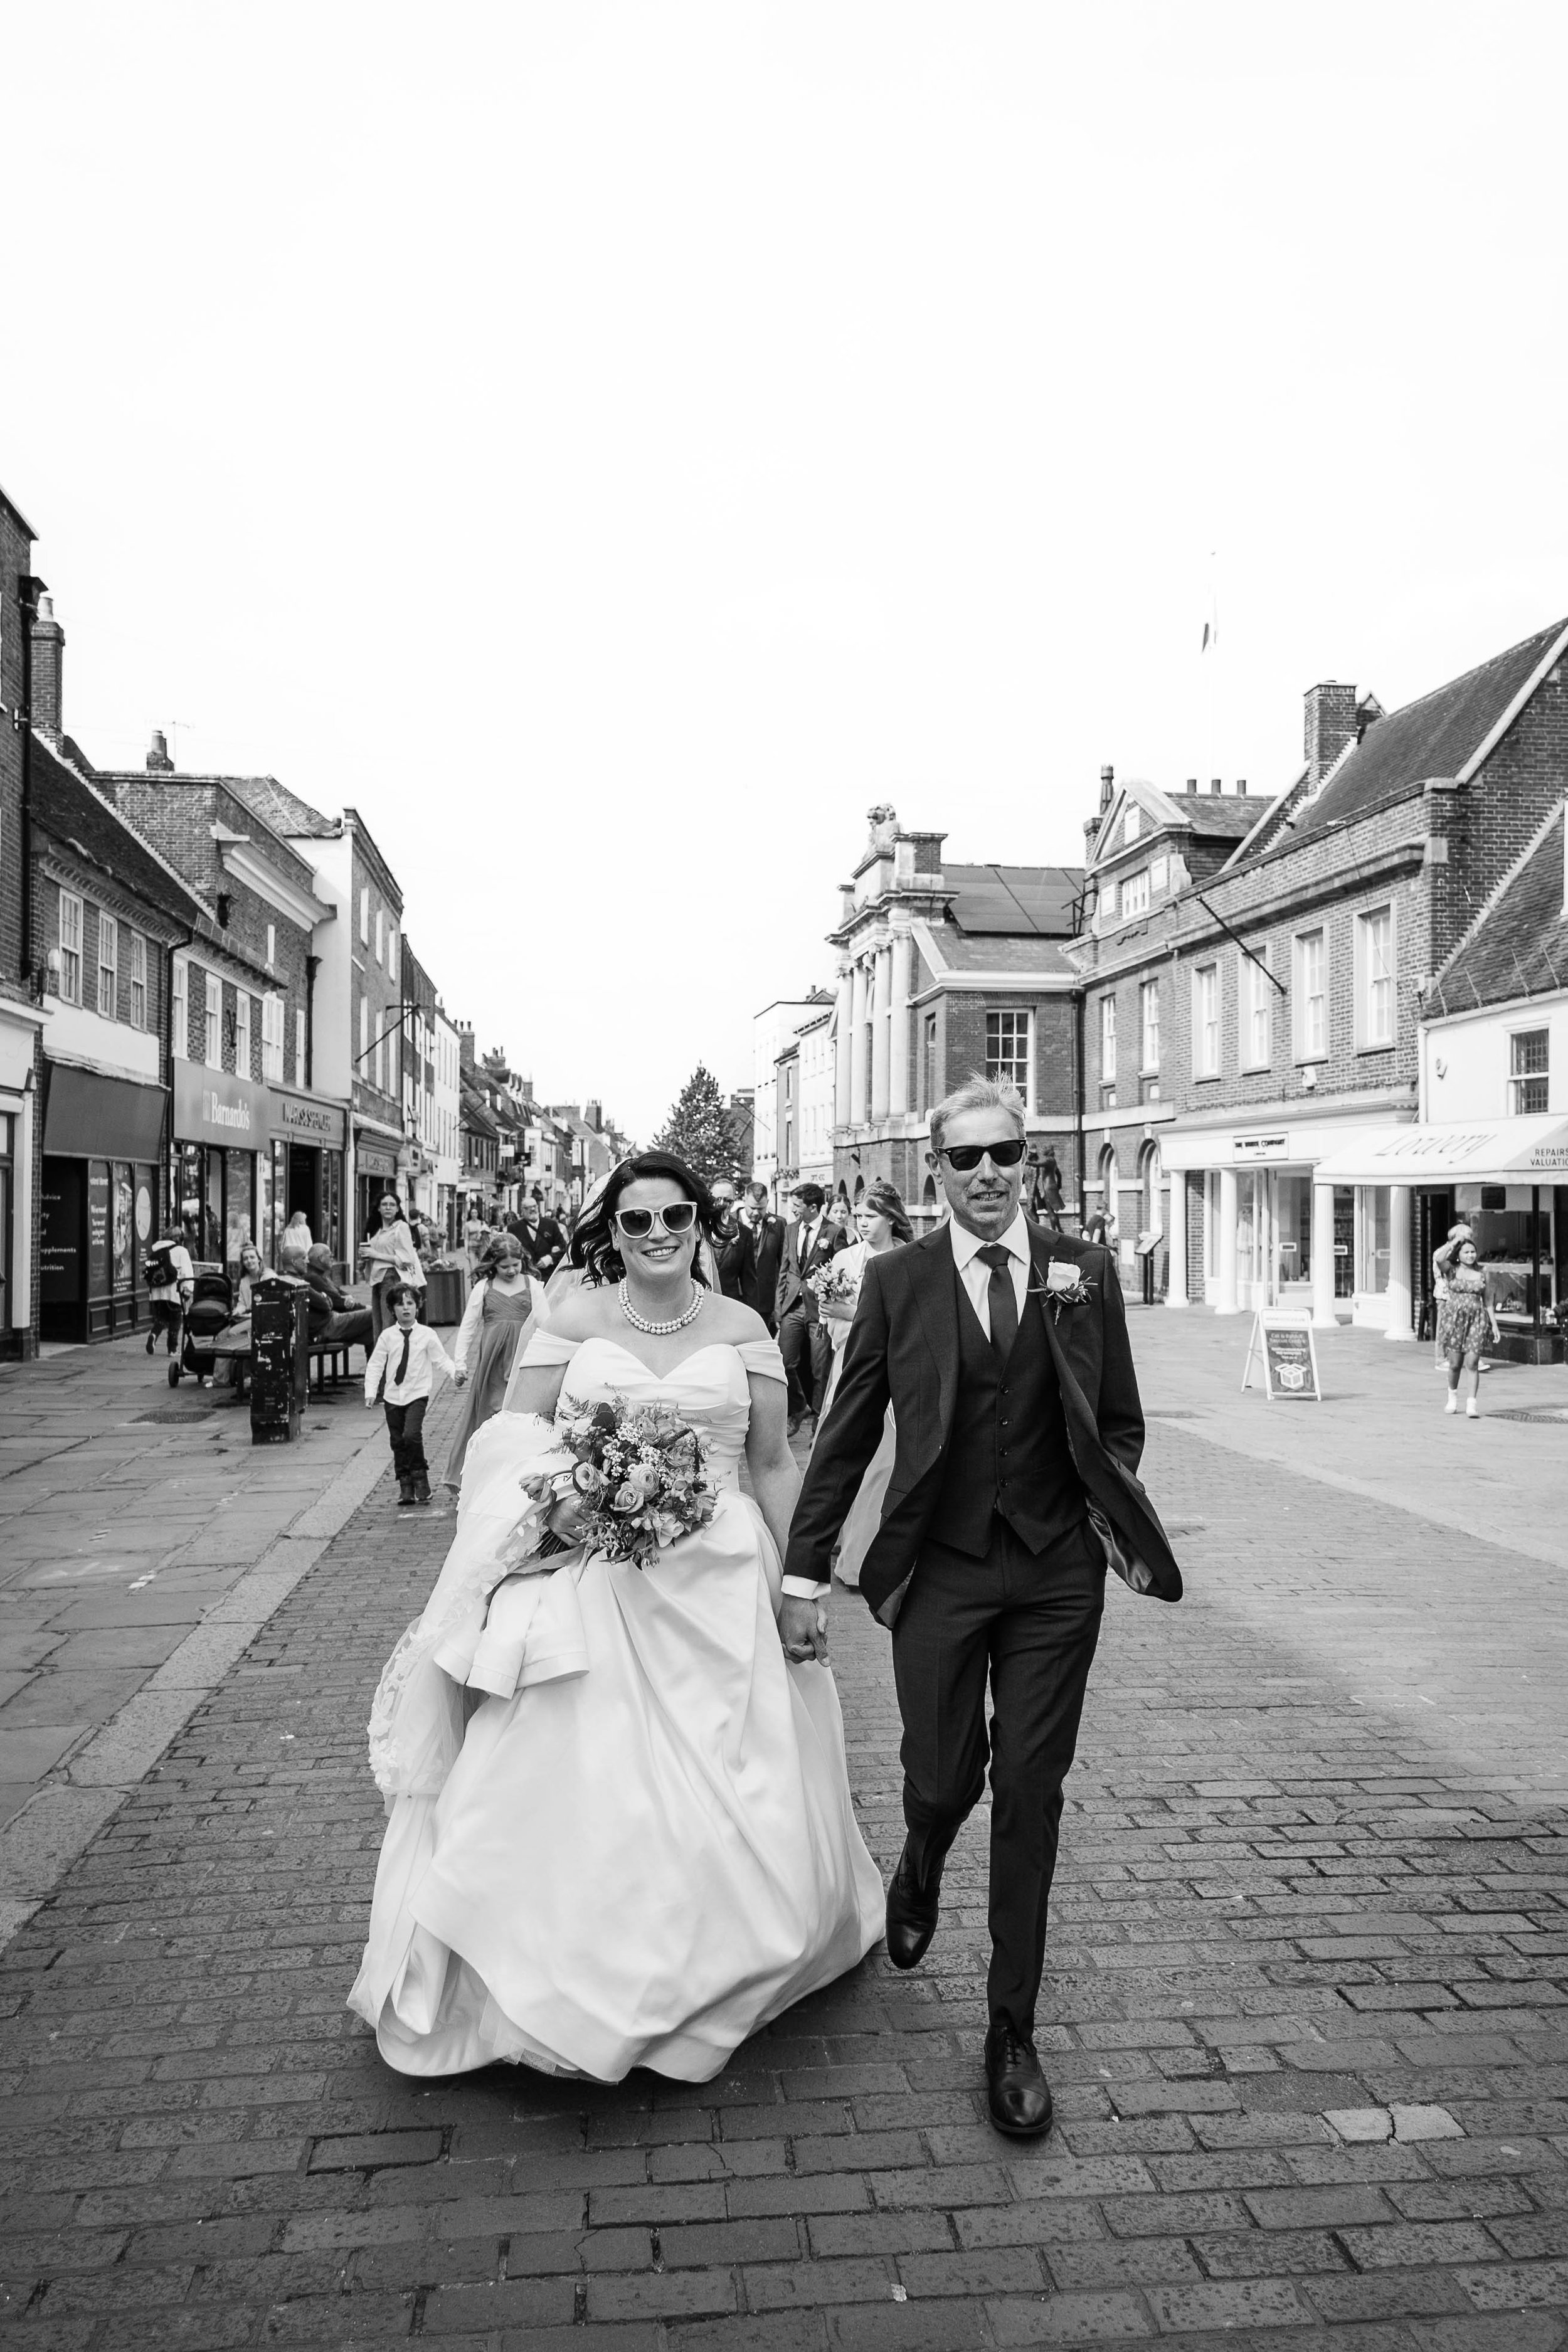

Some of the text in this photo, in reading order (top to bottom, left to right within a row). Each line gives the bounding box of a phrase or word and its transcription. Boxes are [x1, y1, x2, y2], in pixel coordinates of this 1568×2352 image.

[211, 1091, 250, 1130] Barnardo's
[1261, 1138, 1285, 1147] COMPANY
[40, 1246, 77, 1255] upplements
